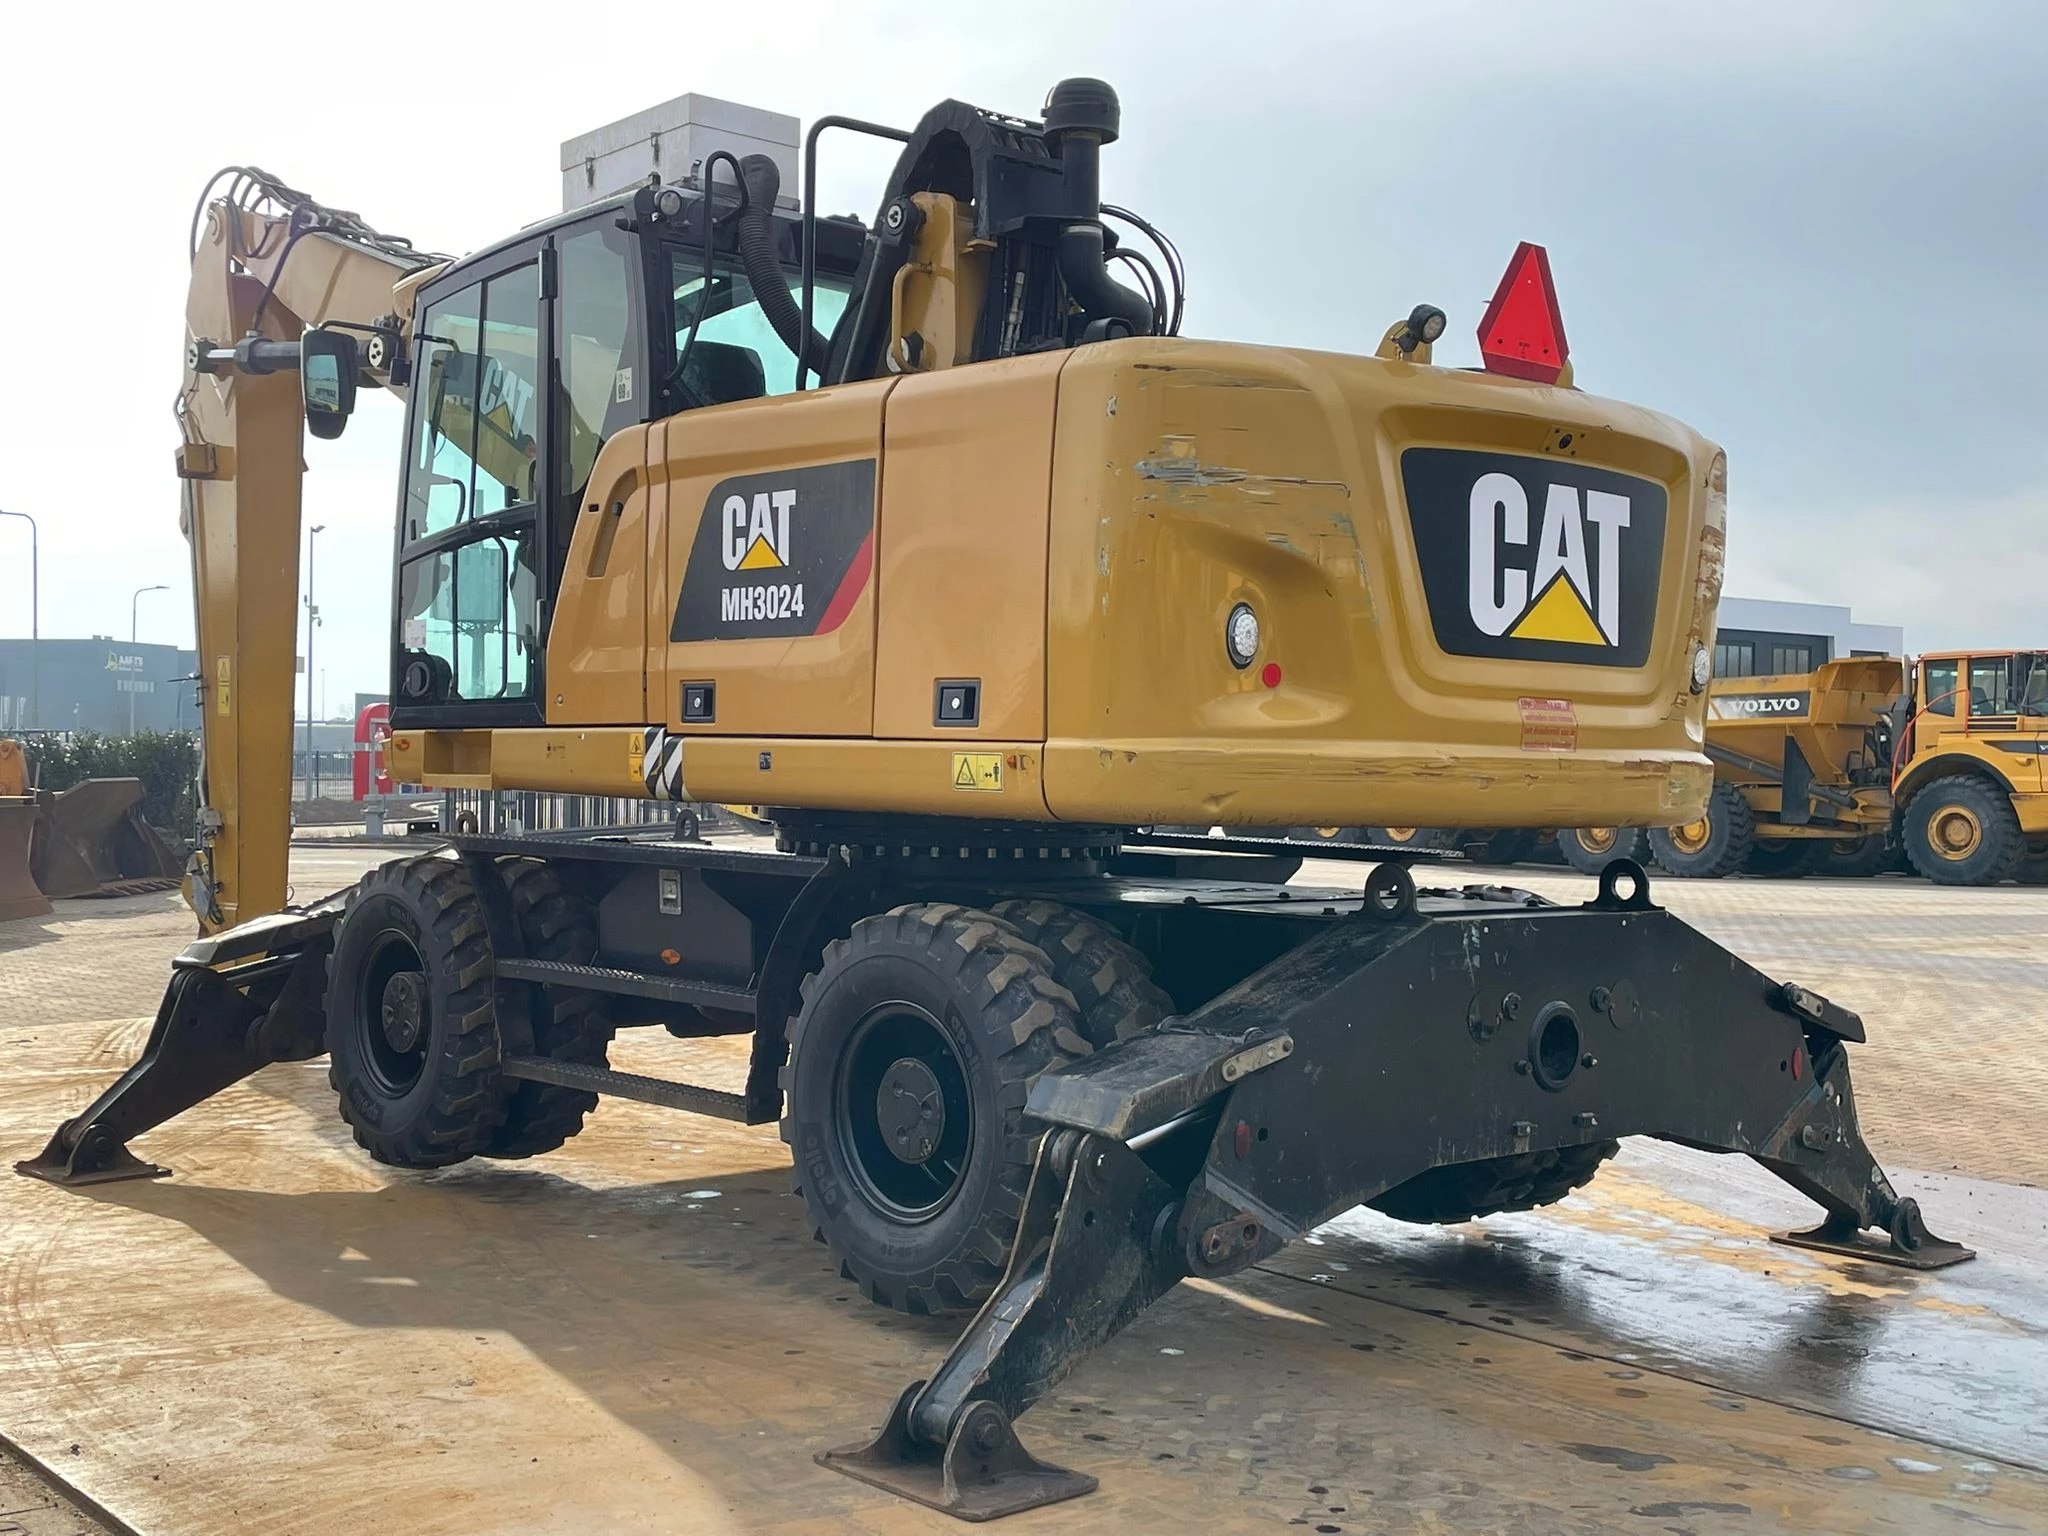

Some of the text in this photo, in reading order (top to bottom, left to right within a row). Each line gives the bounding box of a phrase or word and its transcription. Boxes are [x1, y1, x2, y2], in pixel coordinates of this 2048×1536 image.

[479, 357, 534, 441] CAT
[722, 489, 796, 570] CAT
[1469, 472, 1631, 647] CAT
[721, 583, 804, 621] MH3024
[1728, 698, 1799, 712] VOLVO
[806, 1135, 838, 1206] apollo
